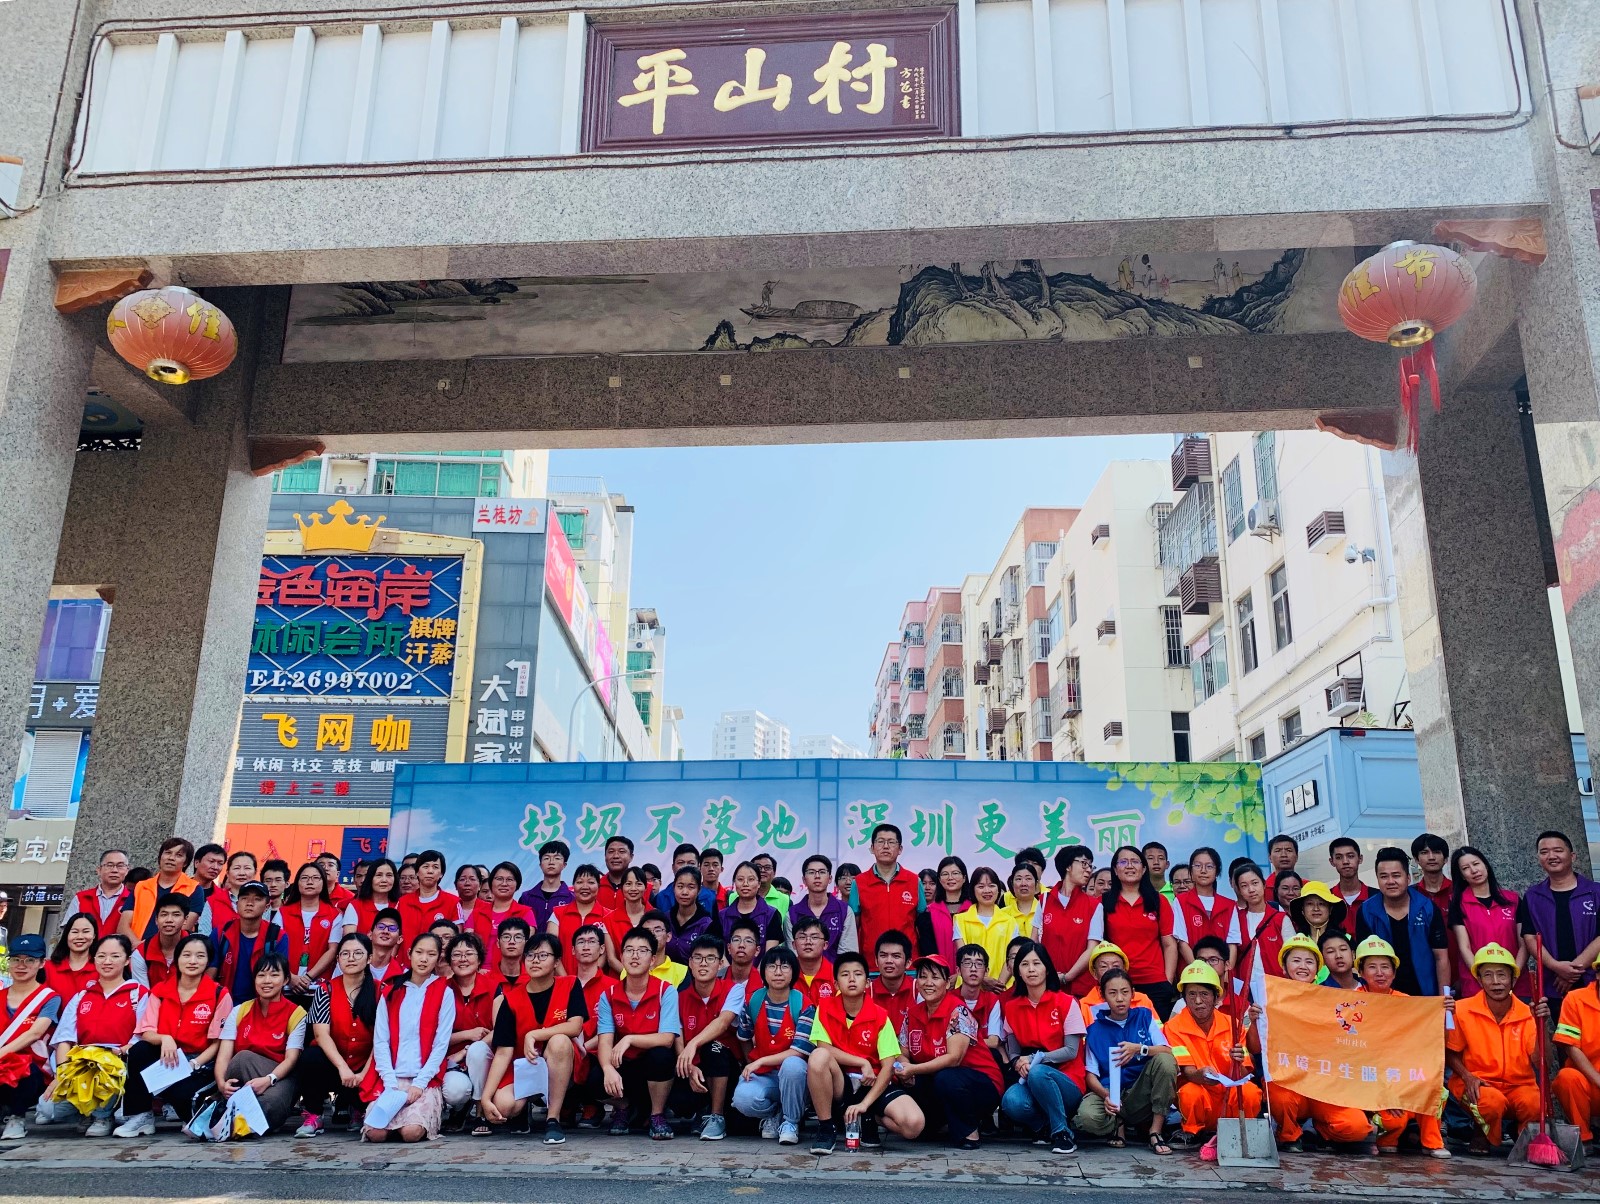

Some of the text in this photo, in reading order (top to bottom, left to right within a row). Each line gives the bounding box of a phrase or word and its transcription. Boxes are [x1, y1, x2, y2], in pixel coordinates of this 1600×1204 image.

[617, 41, 898, 136] 平山村
[477, 504, 523, 525] 兰桂坊
[408, 616, 457, 640] 棋牌
[404, 642, 455, 665] 汗蒸
[261, 713, 412, 753] 飞网咖
[473, 675, 511, 763] 大斌家
[252, 757, 283, 773] 休闲
[291, 758, 323, 773] 社交
[331, 758, 362, 773] 竞技
[259, 780, 350, 796] 请上二楼
[521, 798, 1144, 860] 垃圾不落地 深圳更美丽
[20, 836, 73, 864] 宝岛
[1277, 1052, 1426, 1083] 环境卫生服务队
